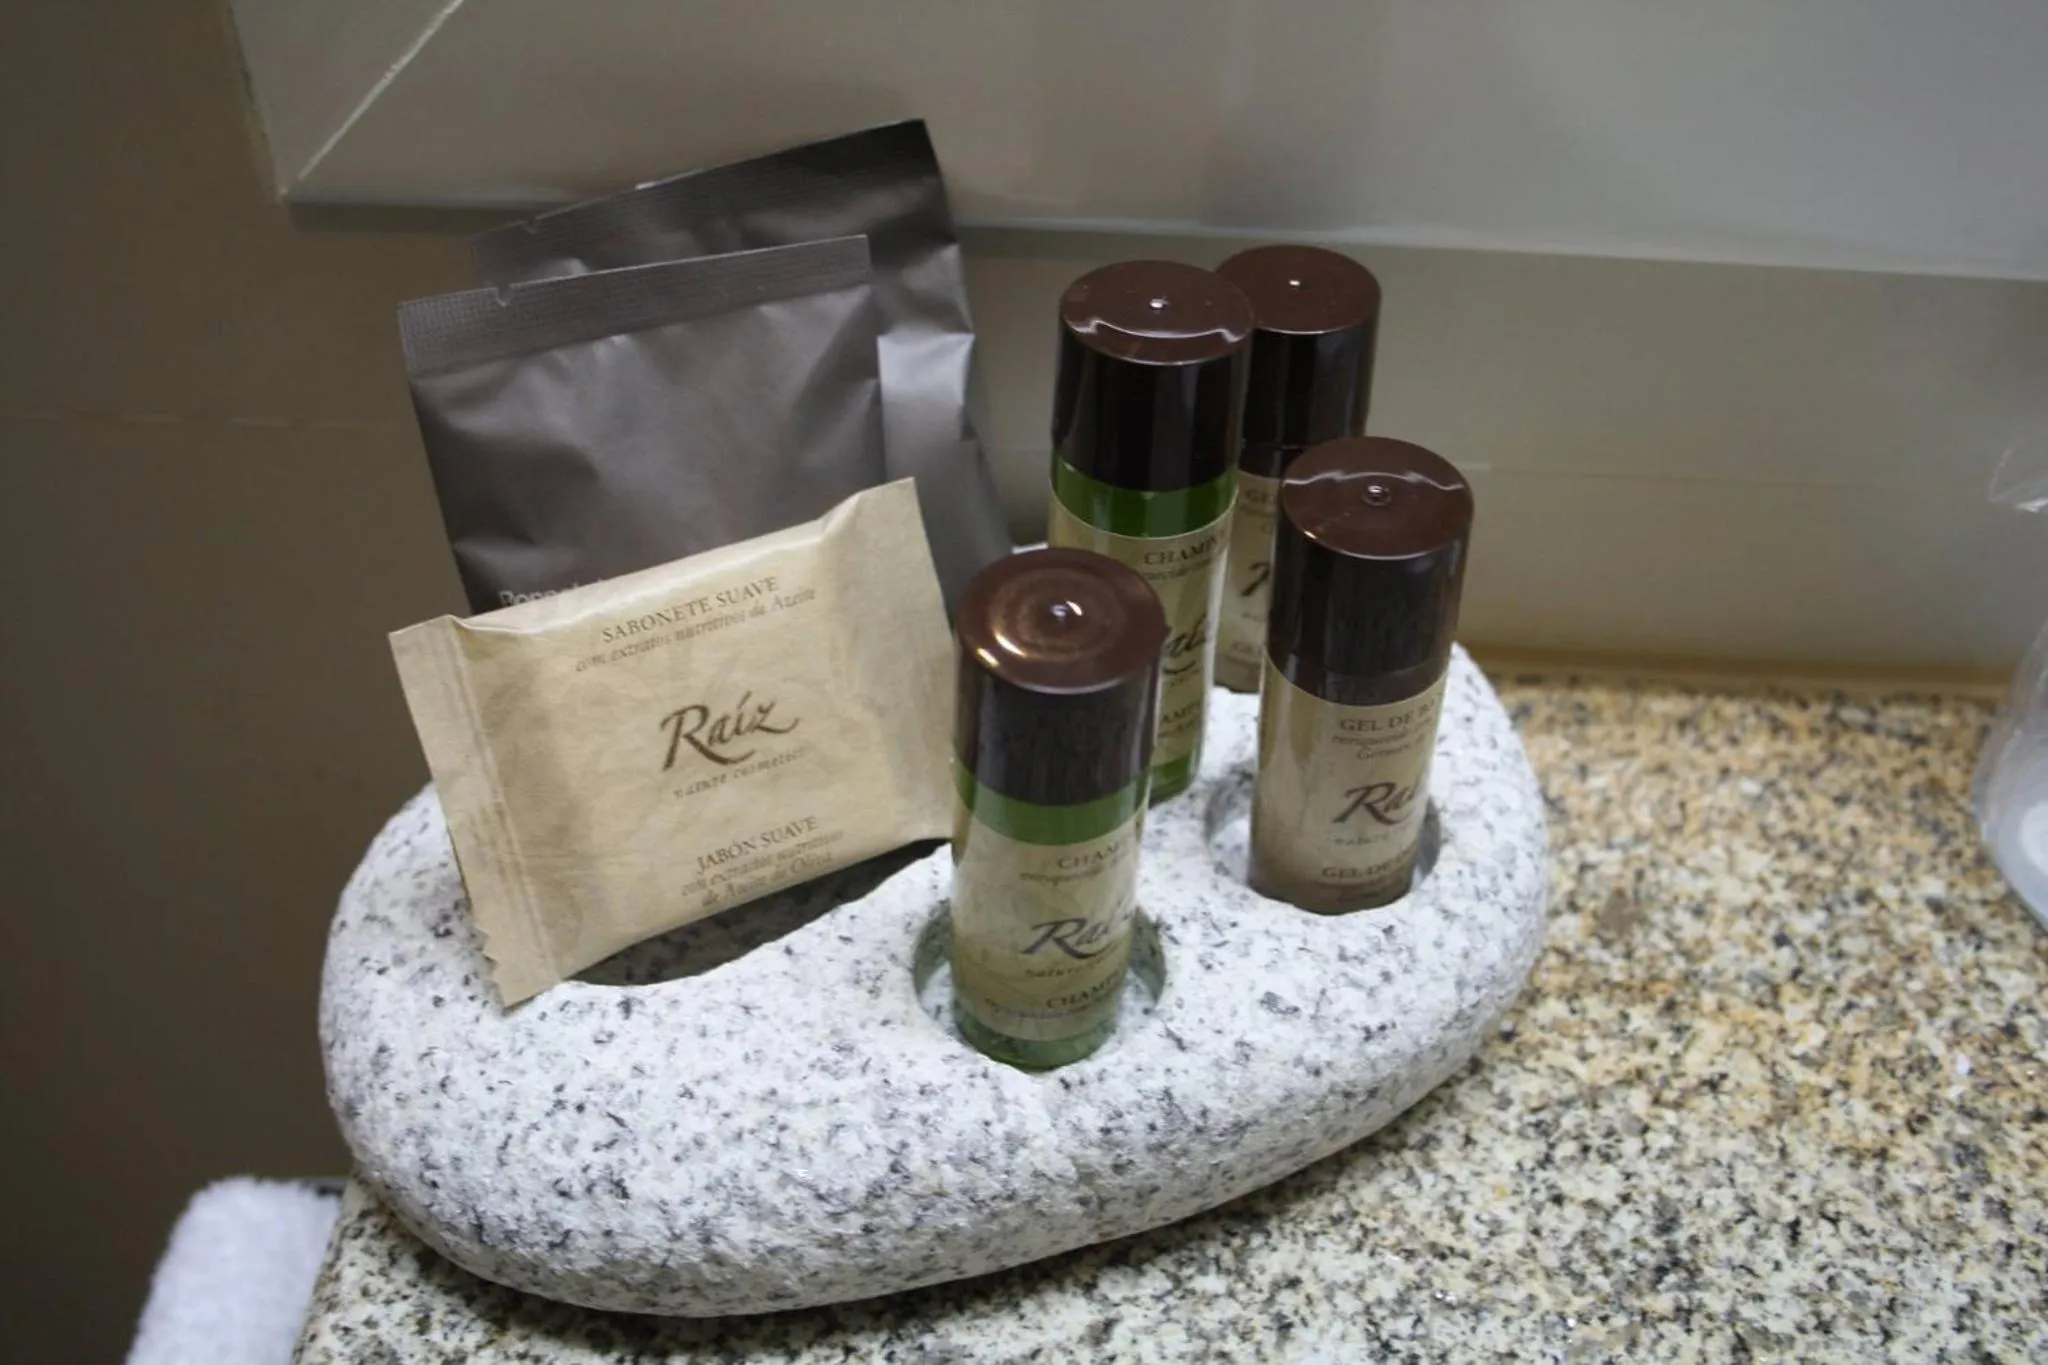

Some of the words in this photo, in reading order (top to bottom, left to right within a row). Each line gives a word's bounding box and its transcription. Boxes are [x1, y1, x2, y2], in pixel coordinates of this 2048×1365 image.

[602, 596, 712, 643] SABONETE
[715, 576, 779, 607] SUAVE
[660, 690, 801, 772] Raíz
[1339, 718, 1384, 732] GEL
[759, 815, 818, 848] SUAVE
